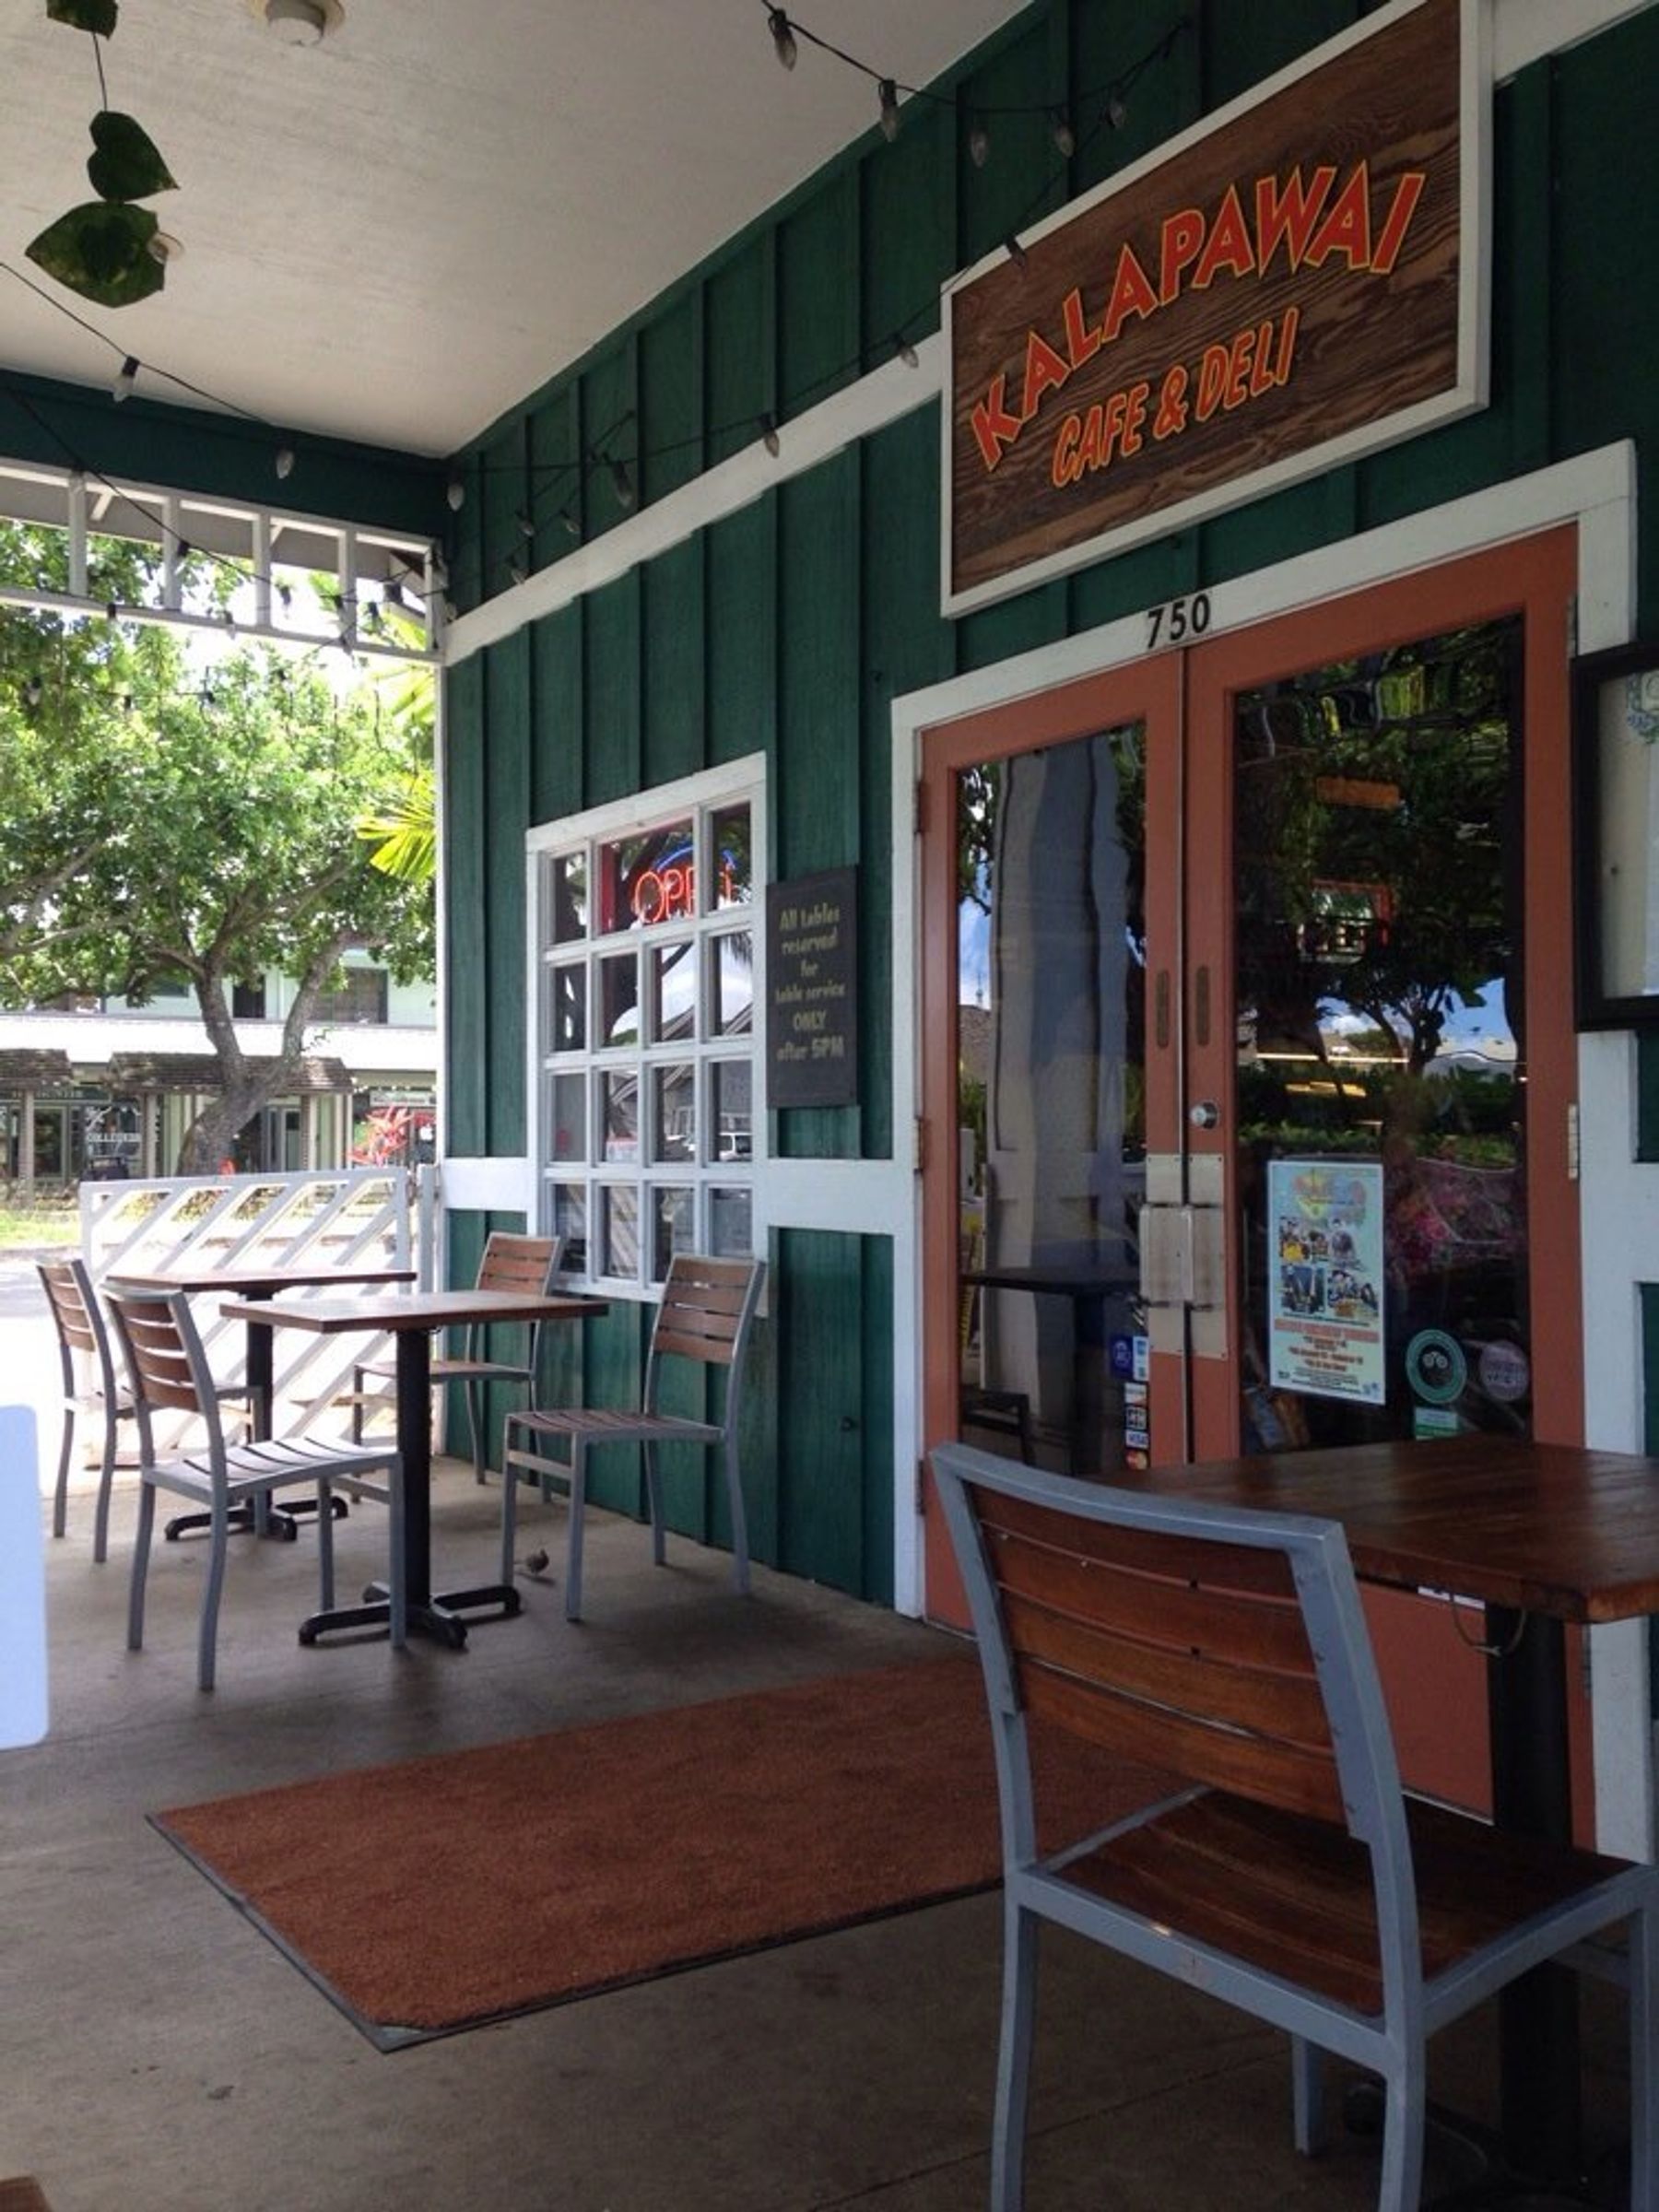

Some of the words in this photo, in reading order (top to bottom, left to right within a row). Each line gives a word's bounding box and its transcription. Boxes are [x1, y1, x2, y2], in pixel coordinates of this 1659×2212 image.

[970, 159, 1426, 473] KALAPAWAI
[1052, 381, 1151, 488] CAFE
[1153, 366, 1189, 441] &
[1196, 306, 1301, 423] DELI
[1147, 593, 1211, 650] 750
[800, 959, 818, 977] for
